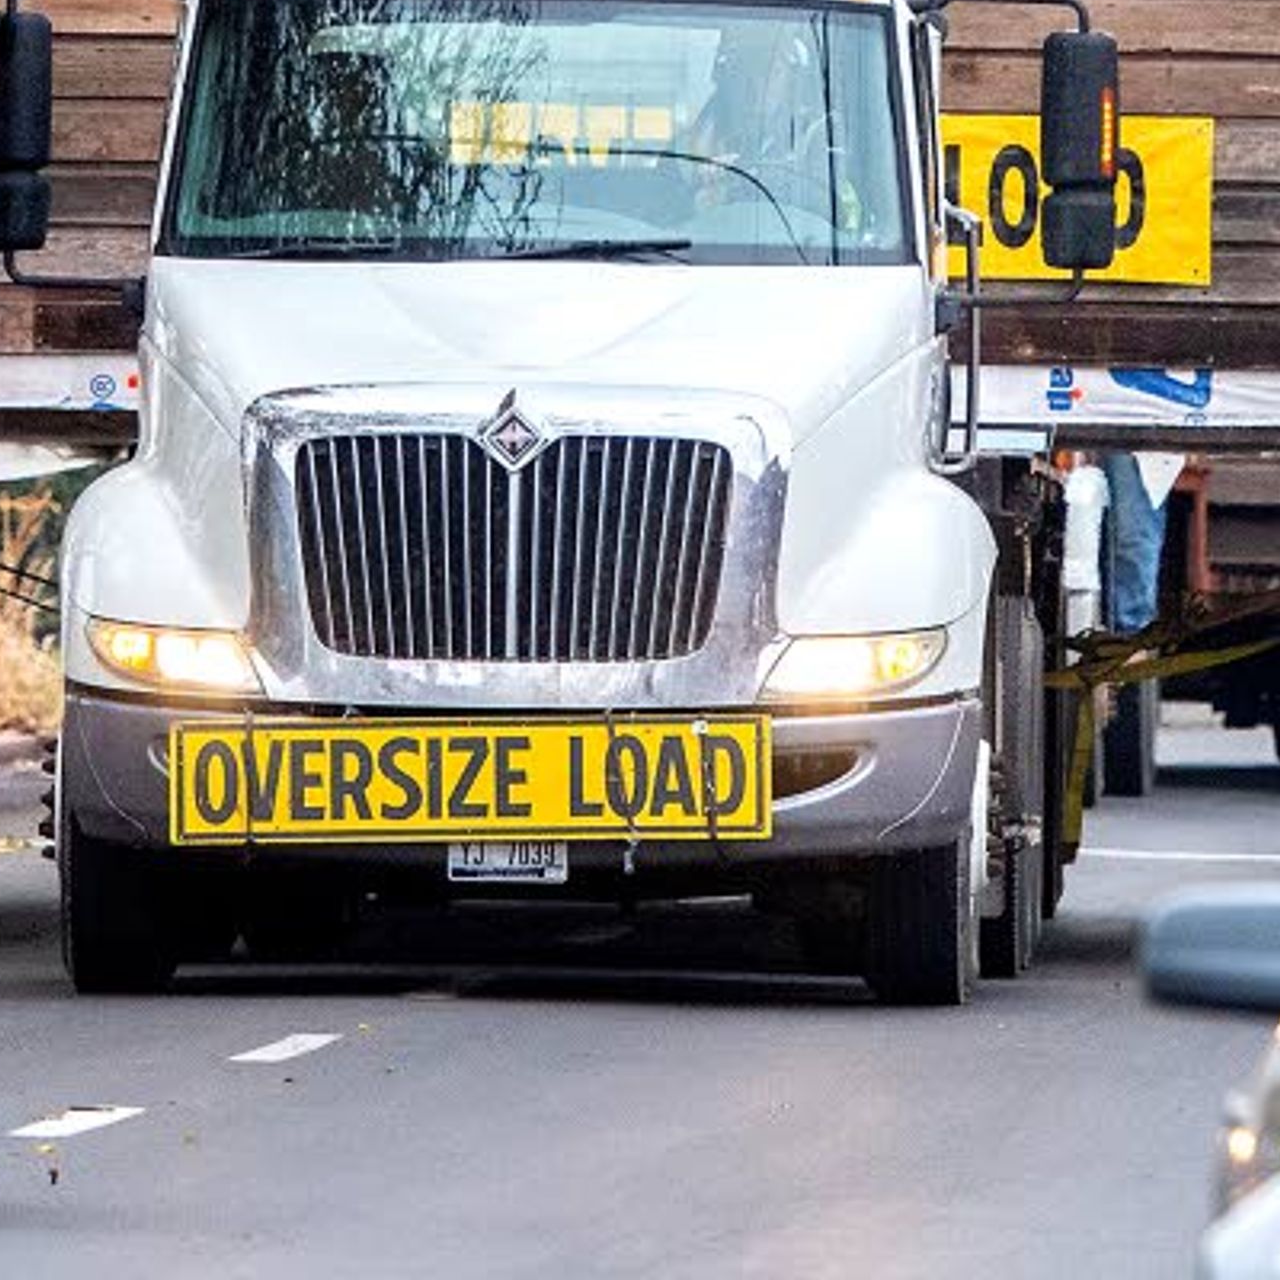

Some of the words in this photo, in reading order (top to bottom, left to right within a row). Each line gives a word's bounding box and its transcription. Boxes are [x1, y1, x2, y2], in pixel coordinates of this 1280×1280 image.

[944, 144, 1147, 249] LOD
[194, 736, 532, 825] OVERSIZE
[570, 734, 746, 819] LOAD
